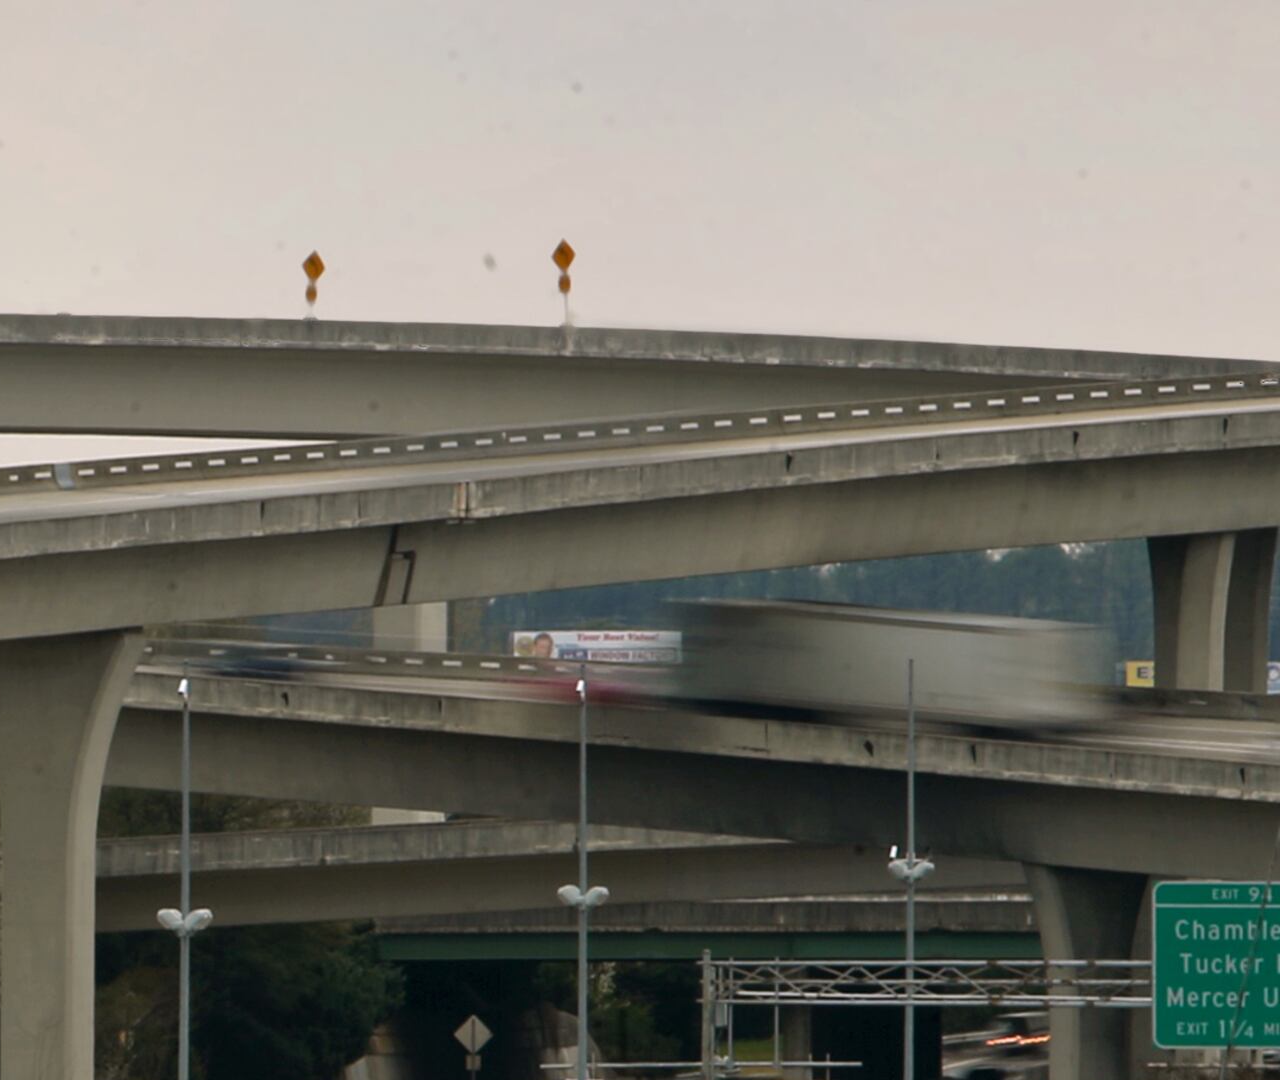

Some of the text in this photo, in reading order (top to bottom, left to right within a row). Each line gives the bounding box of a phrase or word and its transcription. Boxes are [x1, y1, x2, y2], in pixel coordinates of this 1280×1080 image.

[1212, 888, 1239, 900] EXIT
[1179, 953, 1264, 974] Tucker
[1167, 986, 1250, 1008] Mercer
[1176, 1022, 1208, 1036] EXIT
